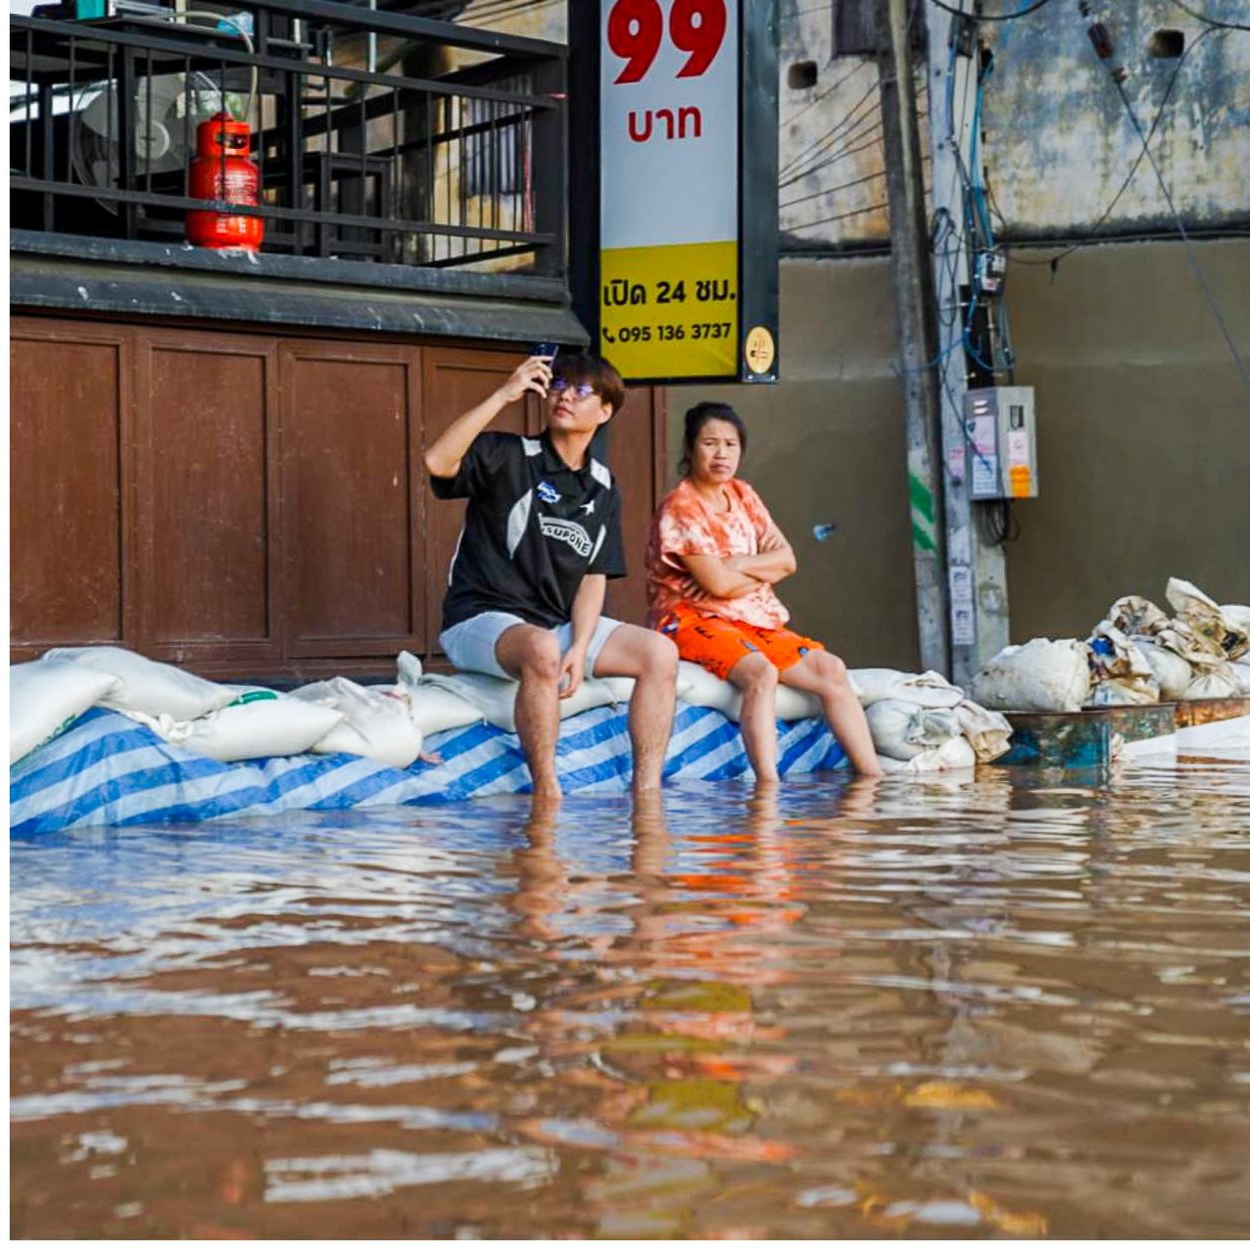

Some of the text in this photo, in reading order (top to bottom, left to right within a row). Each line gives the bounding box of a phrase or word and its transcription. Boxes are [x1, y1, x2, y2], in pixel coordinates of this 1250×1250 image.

[607, 0, 727, 84] 99
[628, 106, 702, 142] บาท
[603, 279, 736, 306] เปิด 24 ชม.
[618, 323, 732, 343] 095 136 3737
